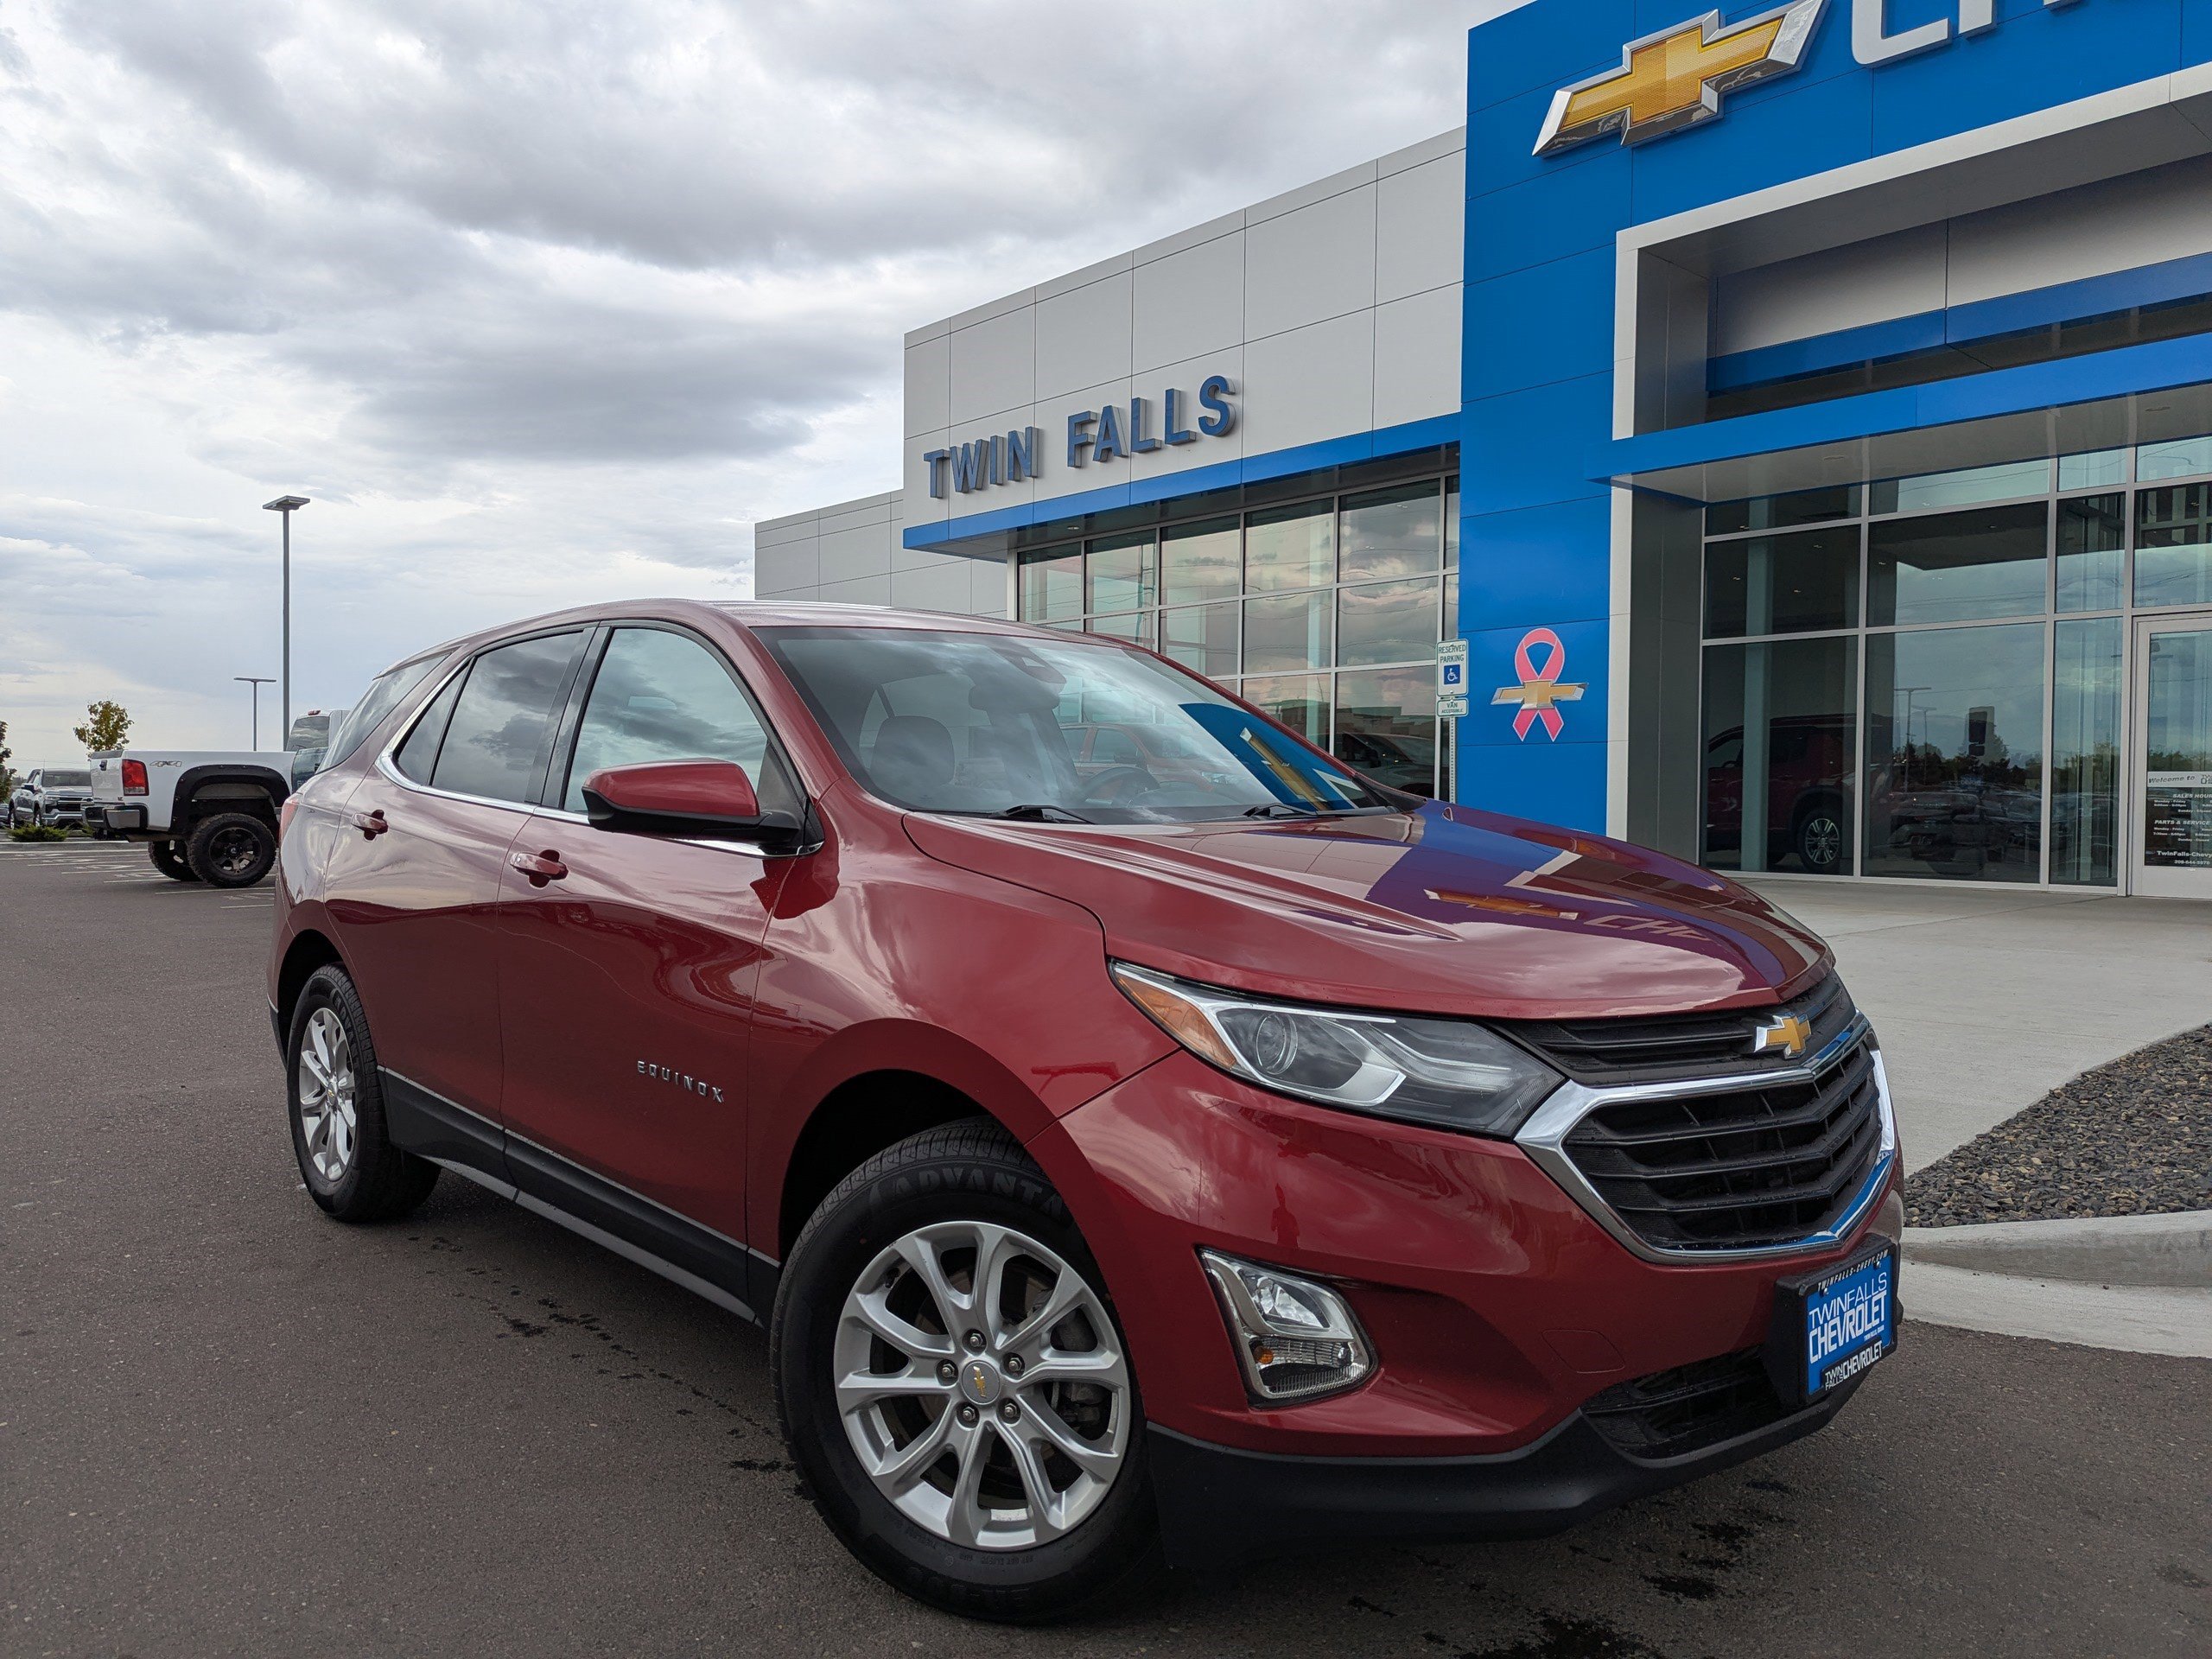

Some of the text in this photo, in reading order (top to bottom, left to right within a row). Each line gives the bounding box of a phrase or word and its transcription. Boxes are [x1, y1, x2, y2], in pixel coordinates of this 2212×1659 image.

[924, 375, 1236, 499] TWIN FALLS
[1438, 645, 1466, 654] RESERVED
[1440, 655, 1465, 664] PARKING
[637, 1060, 725, 1103] EQUINOX
[1809, 1290, 1887, 1364] CHEVROLET
[1825, 1363, 1843, 1383] TWIN
[1842, 1340, 1883, 1381] CHEVROLET
[1825, 1373, 1844, 1391] FALLS
